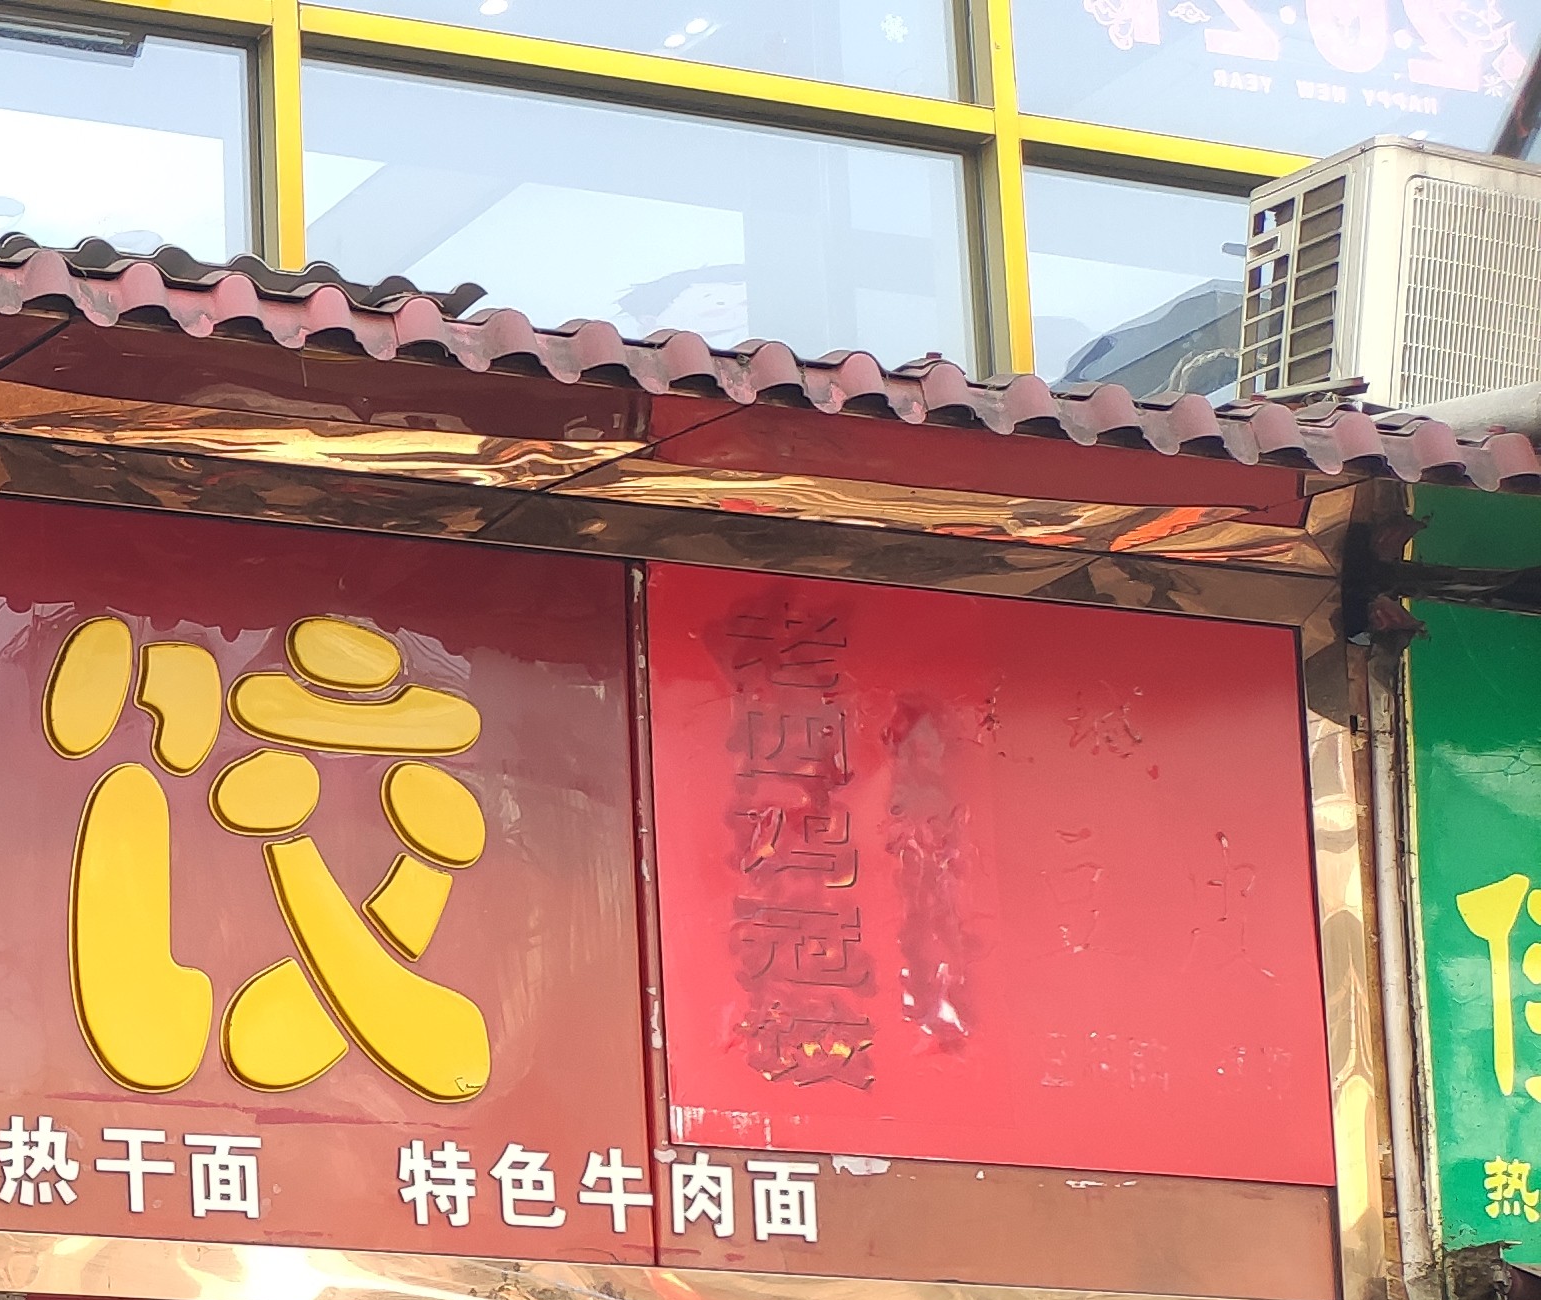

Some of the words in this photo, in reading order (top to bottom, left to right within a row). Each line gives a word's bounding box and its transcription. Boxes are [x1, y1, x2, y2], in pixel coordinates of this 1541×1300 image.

[396, 1140, 821, 1243] 特色牛肉面
